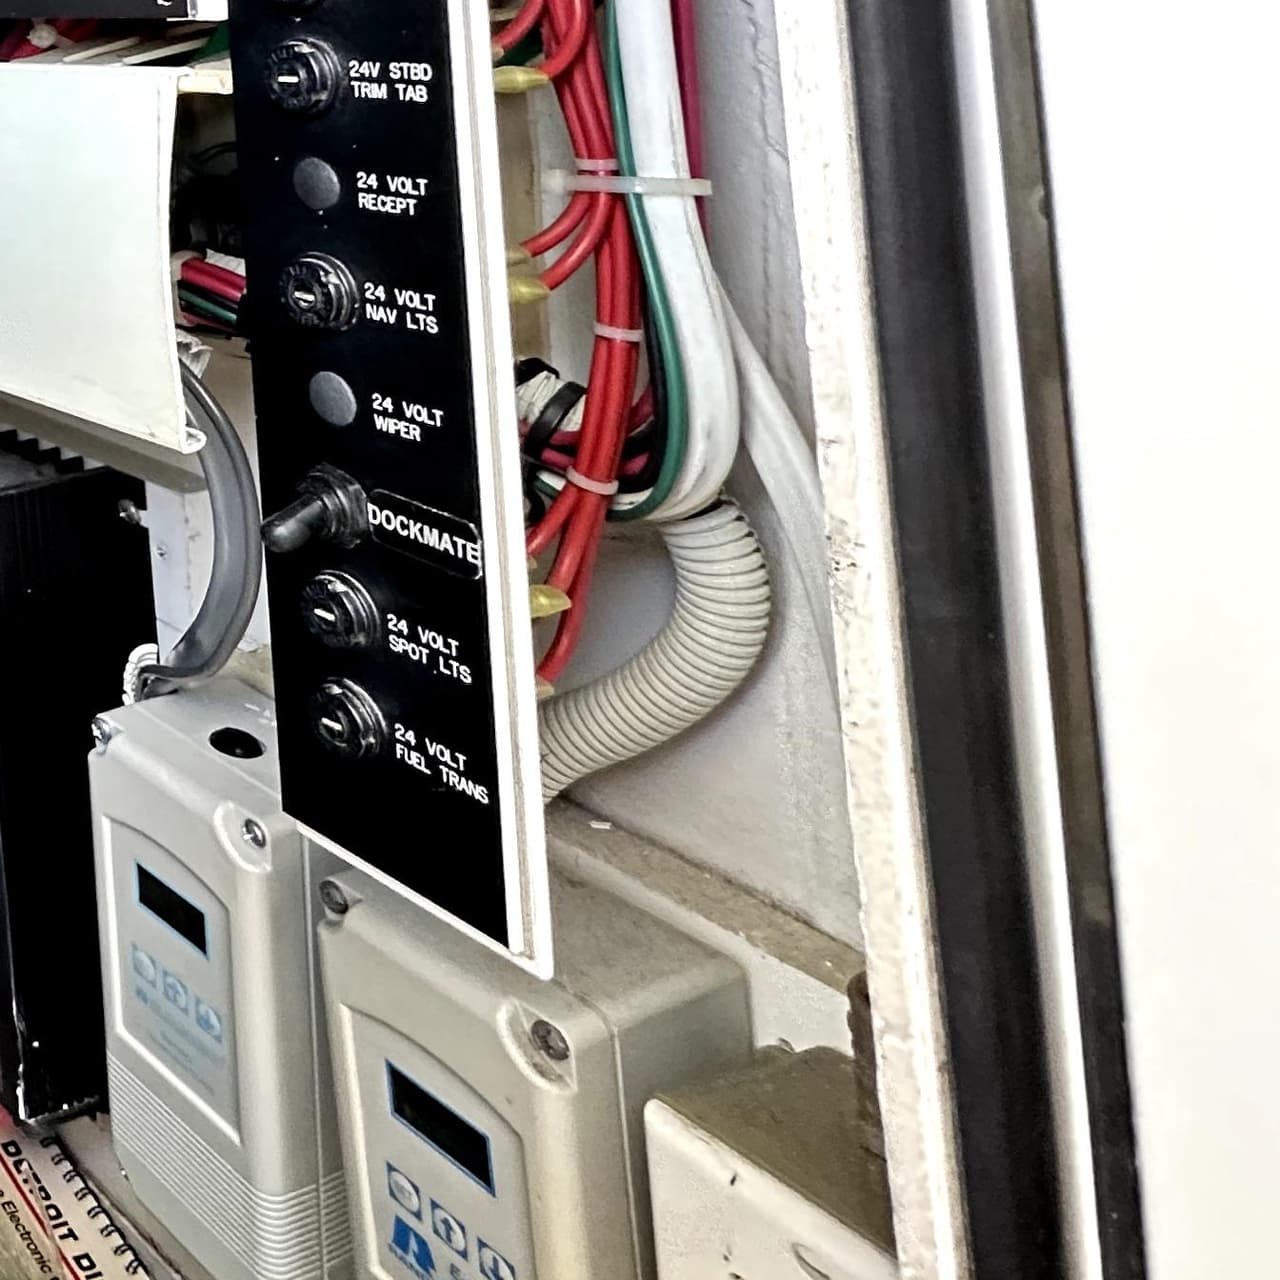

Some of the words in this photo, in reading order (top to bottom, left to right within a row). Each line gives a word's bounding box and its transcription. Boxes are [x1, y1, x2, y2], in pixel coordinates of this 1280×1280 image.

[349, 61, 380, 78] 24V
[390, 61, 433, 81] STBD
[351, 81, 388, 99] TRIM
[395, 84, 428, 103] TAB
[356, 172, 378, 189] 24
[387, 175, 428, 196] VOLT
[358, 193, 417, 215] RECEPT
[364, 283, 385, 301] 24
[395, 289, 435, 311] VOLT
[366, 303, 397, 324] NAV
[406, 312, 438, 333] LTS
[372, 393, 394, 414] 24
[402, 400, 443, 427] VOLT
[374, 413, 421, 442] WIPER
[368, 502, 482, 565] DOCKMATE
[387, 614, 409, 637] 24
[418, 625, 460, 657] VOLT
[389, 634, 428, 664] SPOT
[439, 654, 472, 684] LTS
[395, 723, 417, 746] 24
[425, 736, 467, 770] VOLT
[396, 745, 431, 775] FUEL
[439, 766, 489, 805] TRANS
[1, 1200, 53, 1274] Electronic
